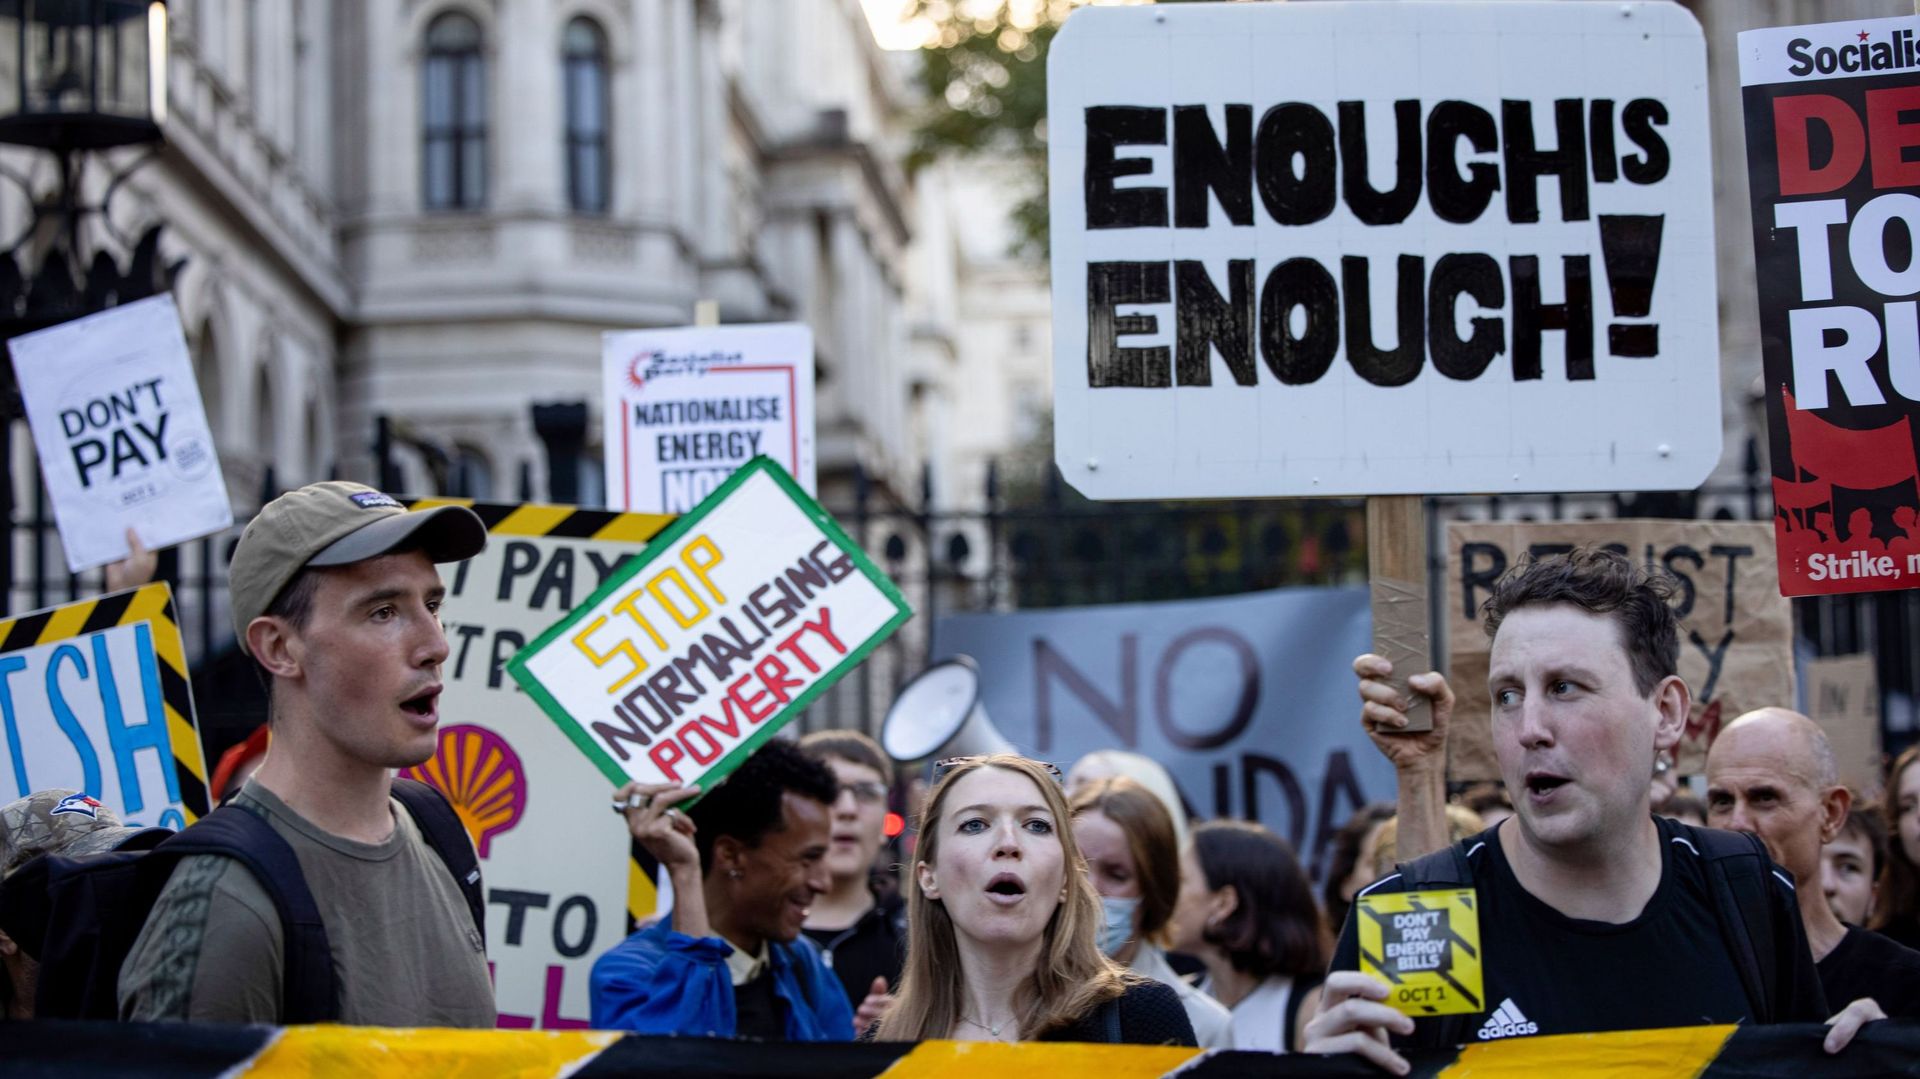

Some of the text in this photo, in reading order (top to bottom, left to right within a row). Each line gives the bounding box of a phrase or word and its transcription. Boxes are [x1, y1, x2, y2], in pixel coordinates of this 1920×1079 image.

[1787, 29, 1920, 76] Sociali
[1084, 98, 1671, 230] ENOUGH IS
[1774, 193, 1920, 301] TO
[1086, 213, 1665, 388] ENOUGH!
[59, 377, 163, 440] DON'T
[634, 396, 782, 427] NATIONALISE
[70, 413, 168, 488] PAY
[656, 430, 762, 463] ENERGY
[662, 467, 738, 513] NO
[1461, 542, 1753, 625] RST
[1807, 550, 1900, 581] Strike,
[571, 533, 727, 695] STOP
[591, 540, 857, 762] NORMALISING
[648, 606, 848, 783] POVERTY
[1032, 625, 1261, 753] NO
[488, 888, 598, 960] TO
[1394, 911, 1441, 929] DON'T
[1402, 926, 1431, 942] PAY
[1386, 938, 1447, 958] ENERGY
[1397, 954, 1440, 970] BILLS
[1398, 986, 1447, 1003] OCT 1
[1478, 1021, 1539, 1040] adidas
